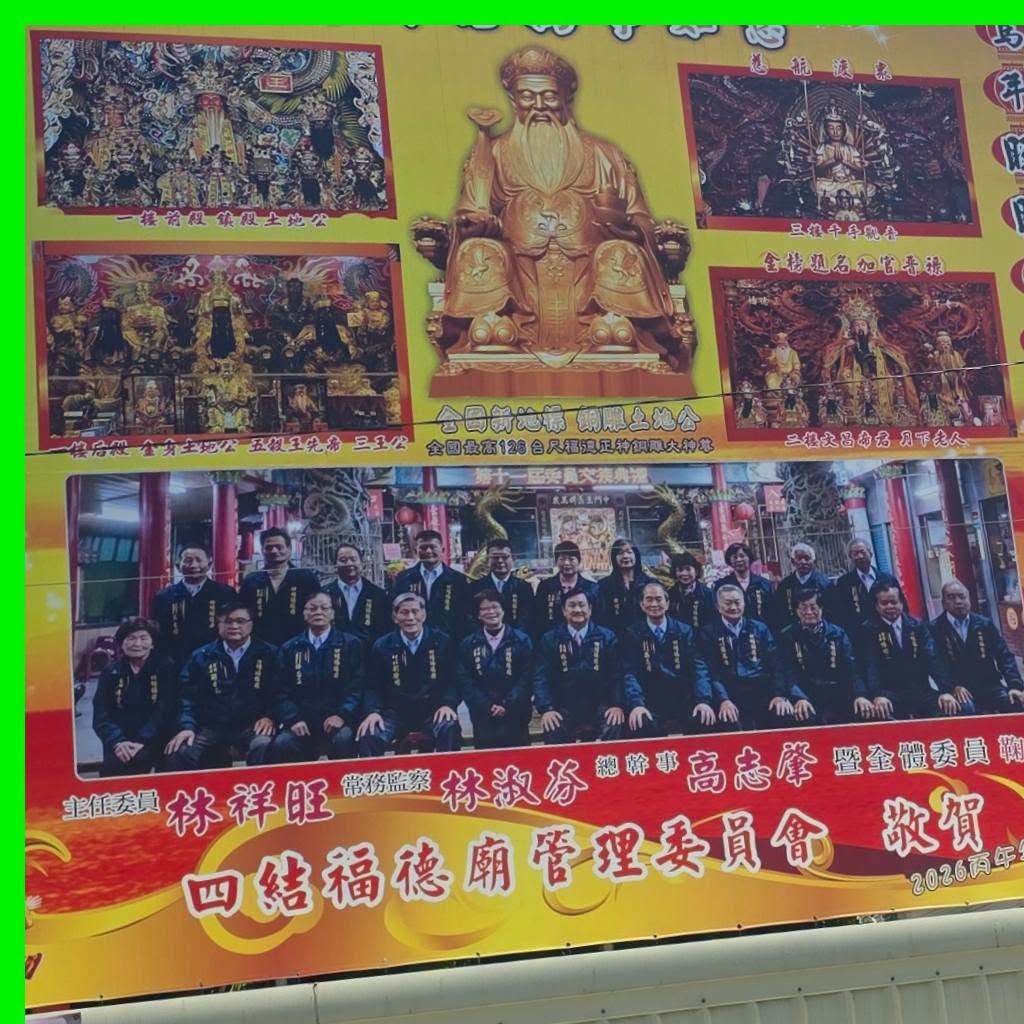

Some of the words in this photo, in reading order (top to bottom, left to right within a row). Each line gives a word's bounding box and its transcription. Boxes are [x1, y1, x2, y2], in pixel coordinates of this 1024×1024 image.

[900, 430, 968, 447] 月下老人
[62, 792, 161, 821] 主任委員
[167, 780, 335, 837] 林祥旺
[342, 769, 432, 797] 常務監察
[440, 759, 588, 812] 林淑芬
[596, 752, 679, 778] 總幹事
[687, 741, 818, 794] 高志肇
[833, 739, 989, 776] 暨全體委員
[182, 808, 829, 917] 四結福德廟管理委員會
[883, 793, 985, 857] 敬賀
